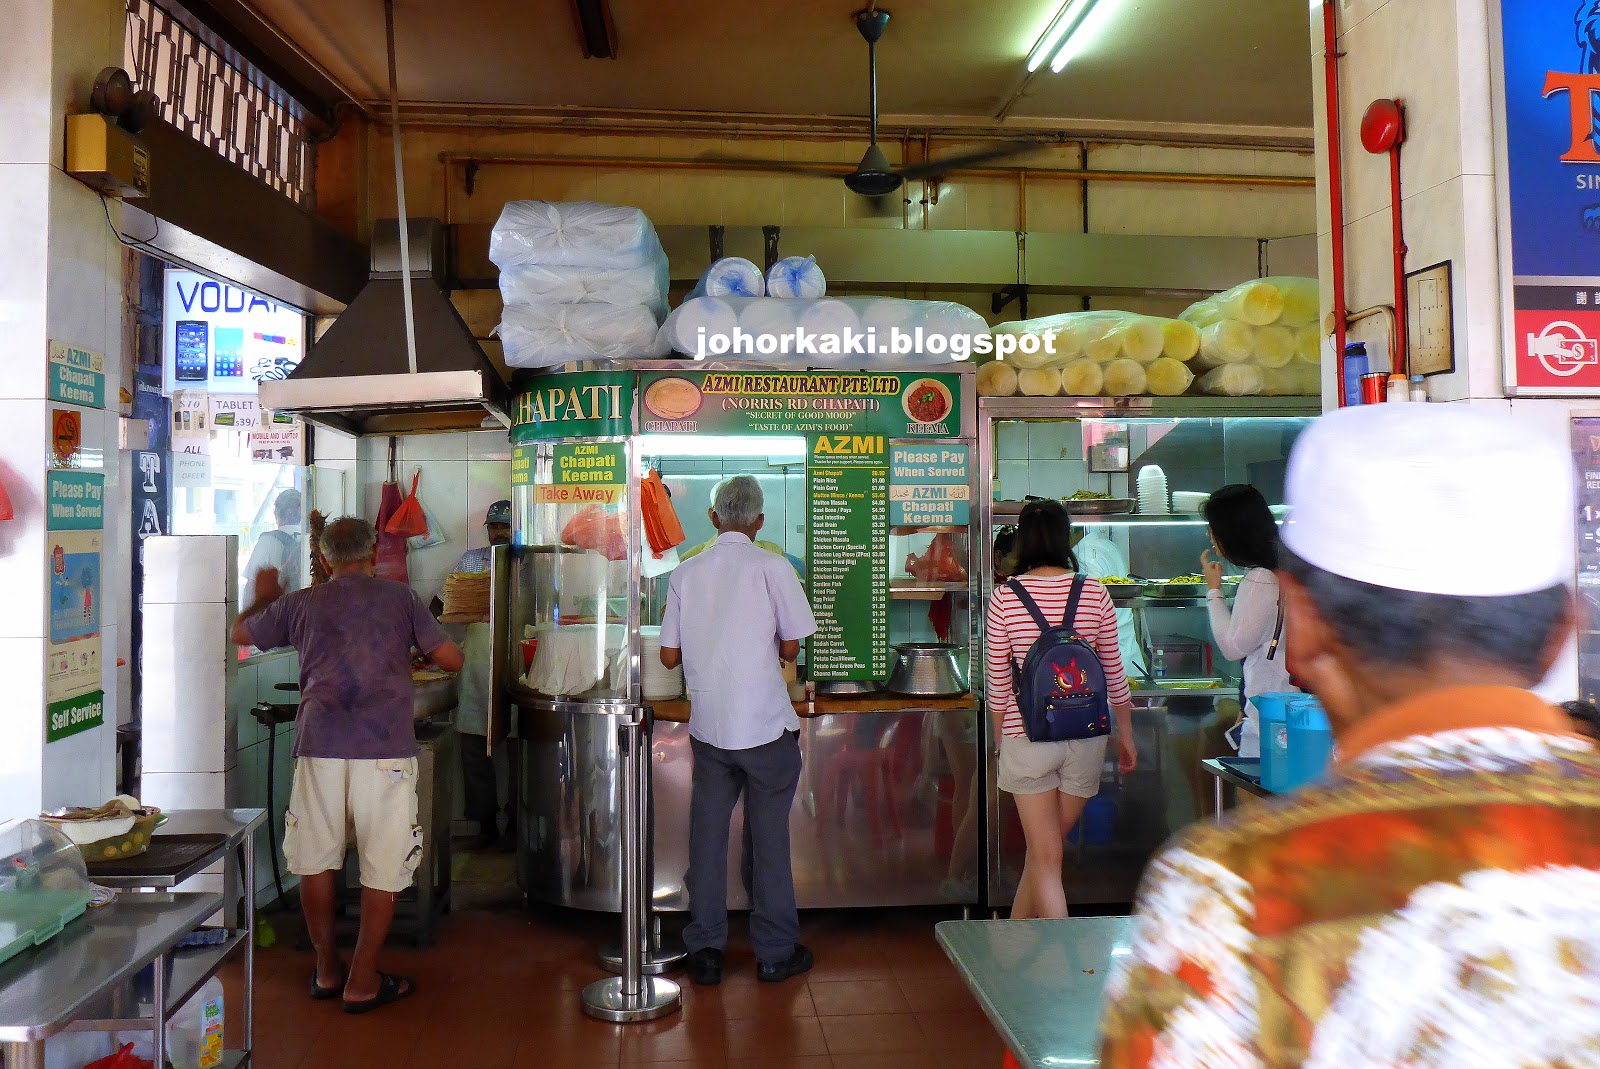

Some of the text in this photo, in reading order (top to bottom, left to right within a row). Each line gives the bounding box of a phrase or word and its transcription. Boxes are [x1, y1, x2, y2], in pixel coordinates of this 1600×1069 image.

[67, 348, 91, 368] AZMI
[59, 366, 95, 386] Chapati
[702, 374, 901, 396] AZMI RESTAURANT PTE LTD
[60, 383, 94, 402] Keema
[216, 401, 254, 410] TABLET
[721, 397, 880, 411] (NORRIS RD CHAPATI)
[784, 411, 796, 420] OF
[798, 412, 824, 420] GOOD
[645, 421, 698, 432] CHAPATI
[781, 423, 794, 432] OF
[906, 422, 950, 434] KEEMA
[252, 432, 299, 440] MOBILE AND LAPTOP
[183, 445, 202, 454] ALL
[575, 445, 599, 455] AZMI
[813, 435, 884, 454] AZMI
[560, 455, 616, 469] Chapati
[894, 451, 965, 465] Please Pay
[562, 470, 614, 482] Keema
[894, 467, 965, 477] When Served
[52, 480, 102, 500] Please Pay
[541, 486, 614, 504] Take Away
[912, 487, 947, 499] AZMI
[52, 503, 101, 517] When Served
[902, 501, 954, 513] Chapati
[903, 513, 953, 523] Keema
[52, 702, 102, 731] Self Service
